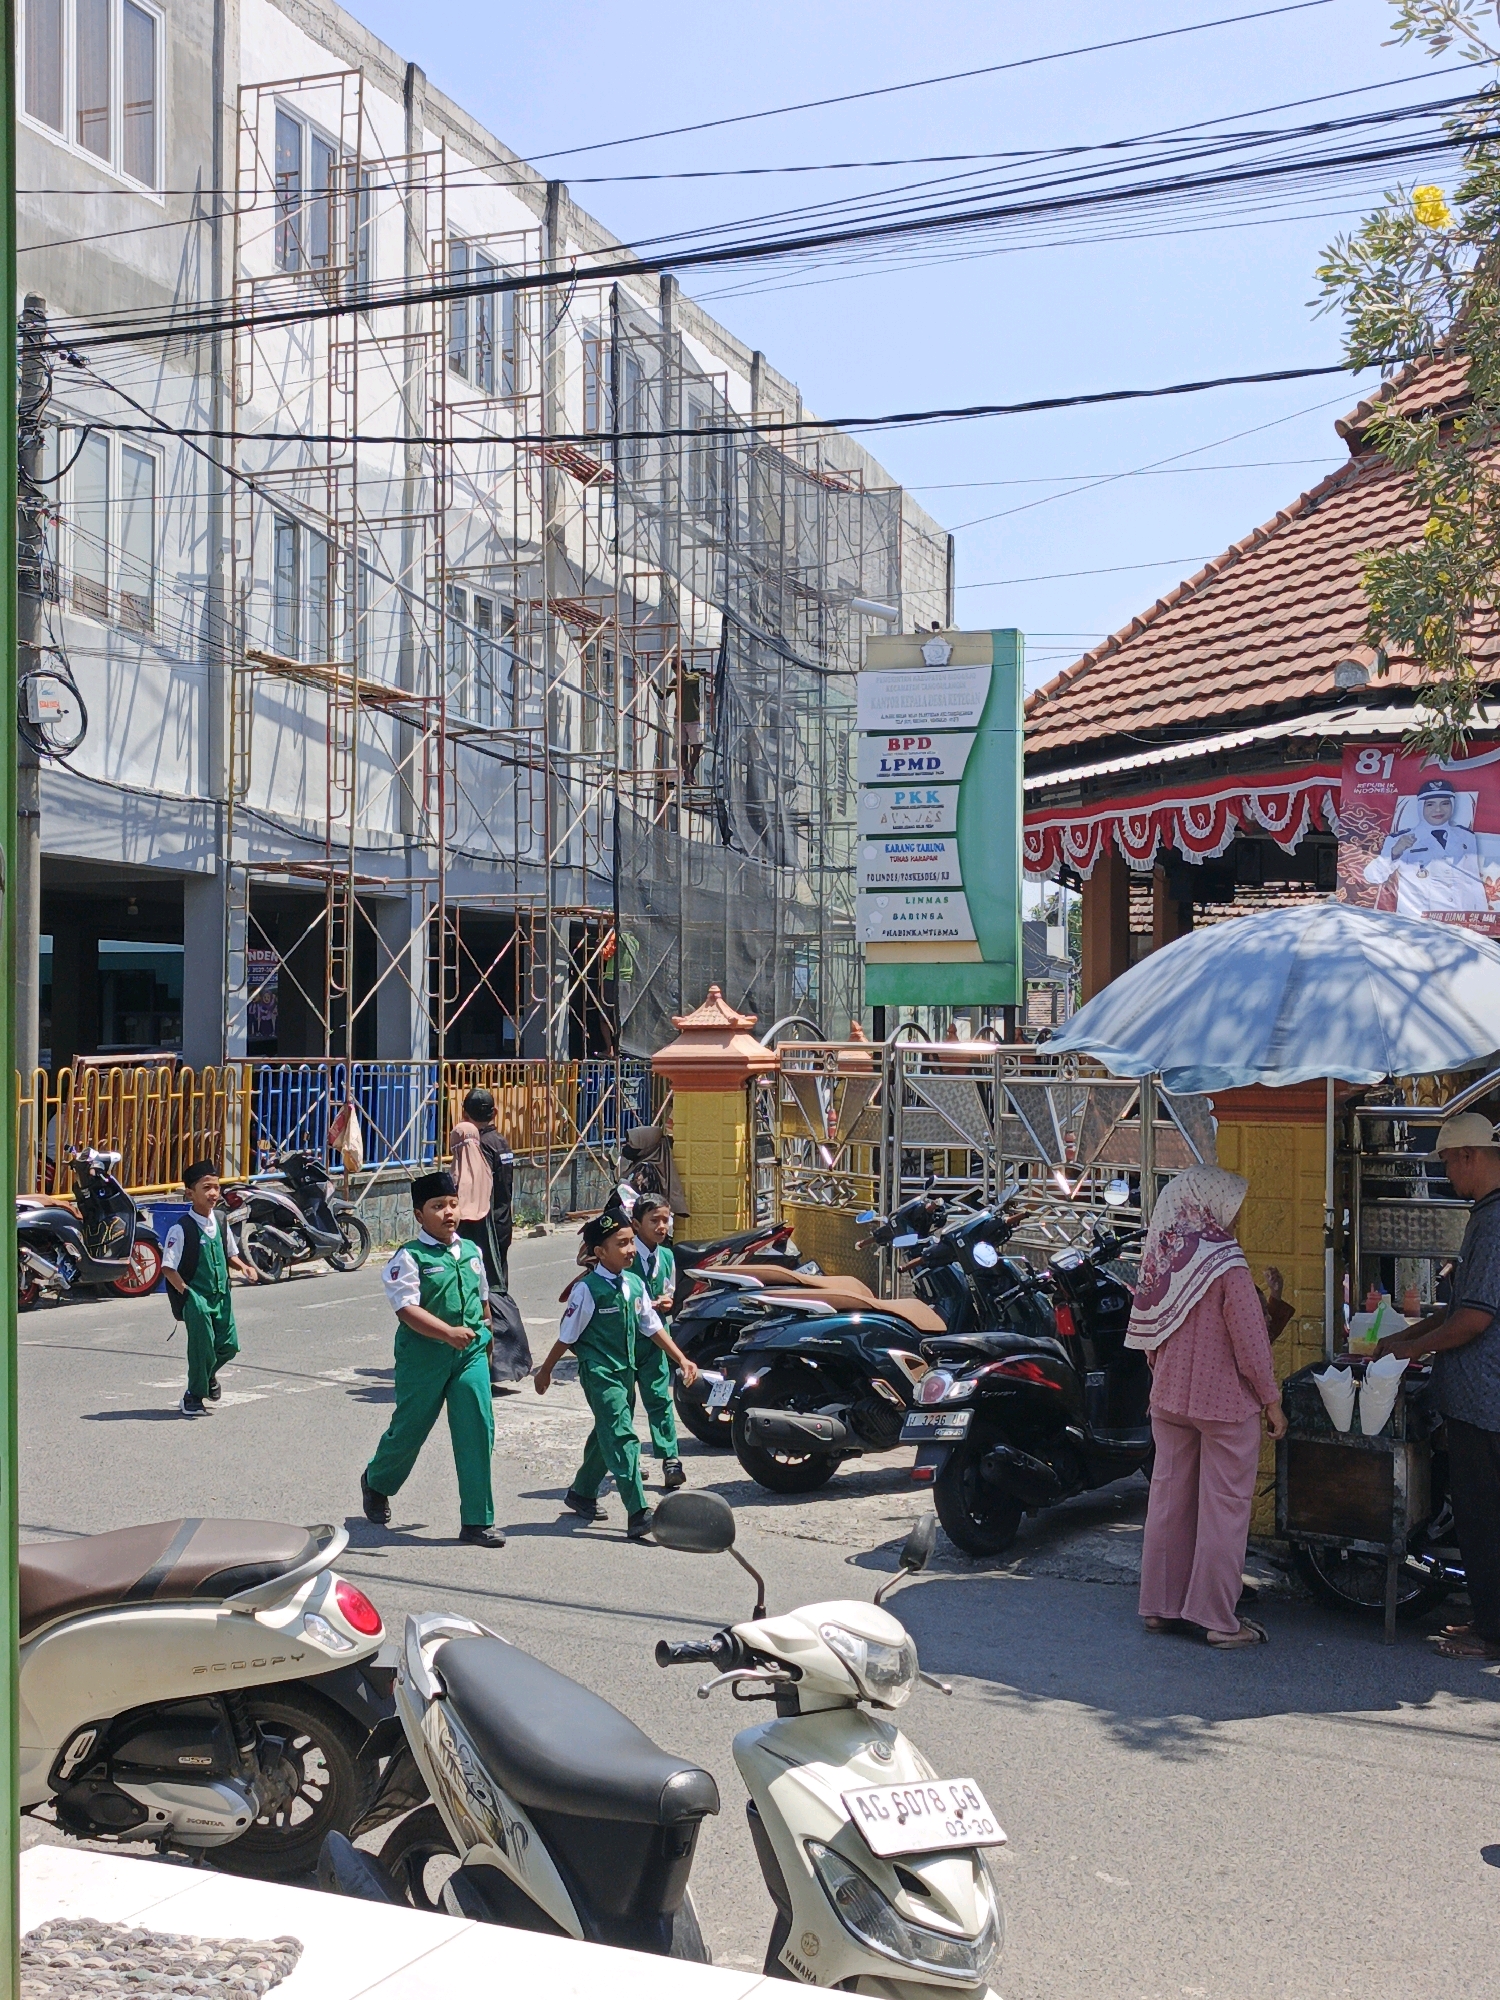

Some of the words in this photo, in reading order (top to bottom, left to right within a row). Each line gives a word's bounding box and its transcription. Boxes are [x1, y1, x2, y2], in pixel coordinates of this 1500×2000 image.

[888, 736, 932, 751] BPD
[880, 757, 942, 772] LPMD
[1355, 748, 1395, 779] 81
[894, 790, 941, 804] PKK
[1353, 787, 1399, 795] INDONESIA
[905, 896, 949, 904] LINMAS
[892, 912, 944, 920] BABINSA
[921, 1414, 947, 1426] 3296
[192, 1652, 305, 1676] SCOOPY
[856, 1793, 890, 1822] AG
[891, 1787, 946, 1818] 6078
[186, 1817, 225, 1827] HONDA
[785, 1949, 817, 1984] YAMAHA
